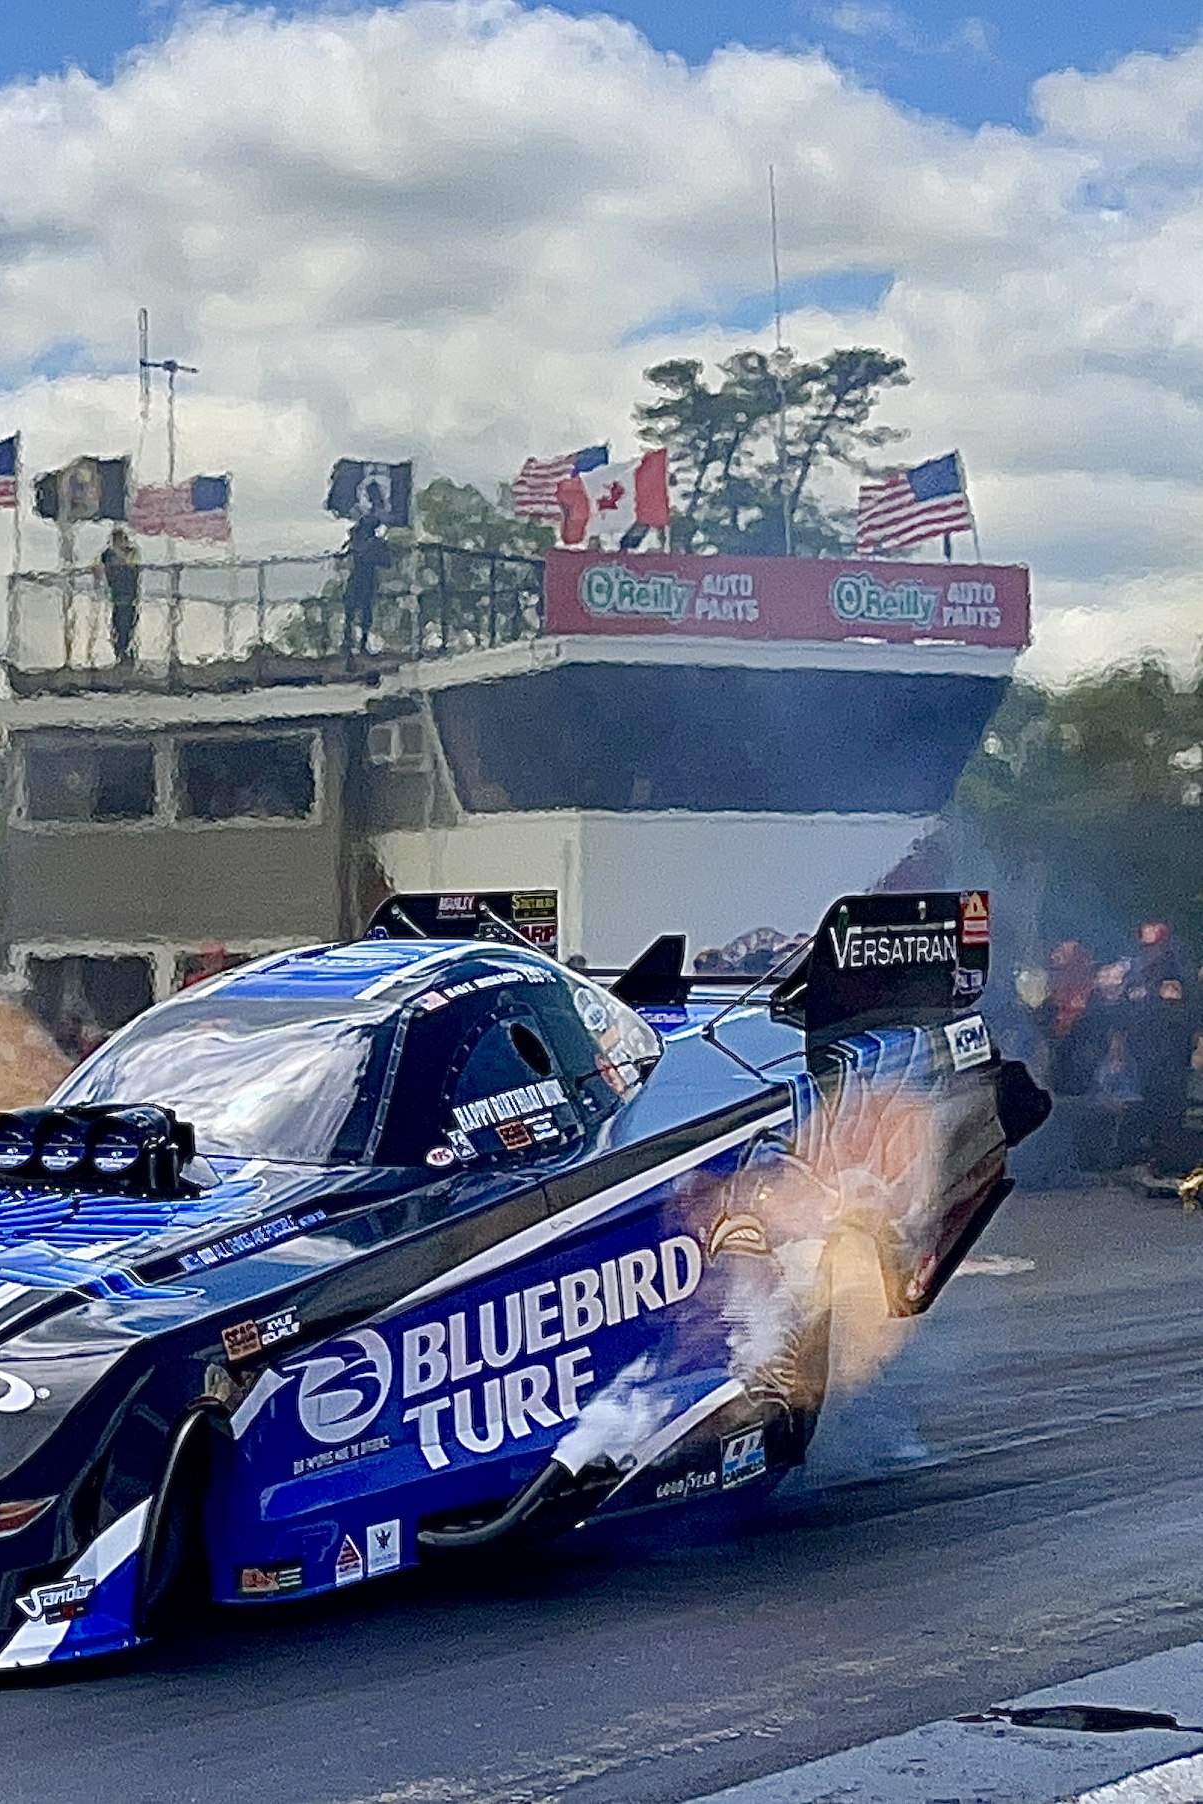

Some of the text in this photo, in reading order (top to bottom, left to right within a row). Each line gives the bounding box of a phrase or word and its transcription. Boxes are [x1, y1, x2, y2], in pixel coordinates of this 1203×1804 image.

[584, 567, 691, 621] O'Reilly
[702, 574, 753, 596] AUTO
[832, 575, 938, 627] O'Reilly
[948, 582, 996, 604] AUTO
[695, 598, 759, 621] PARTS
[943, 606, 1000, 628] PARTS
[829, 926, 957, 969] VERSATRAN
[403, 1234, 702, 1399] BLUEBIRD
[403, 1346, 595, 1470] TURF
